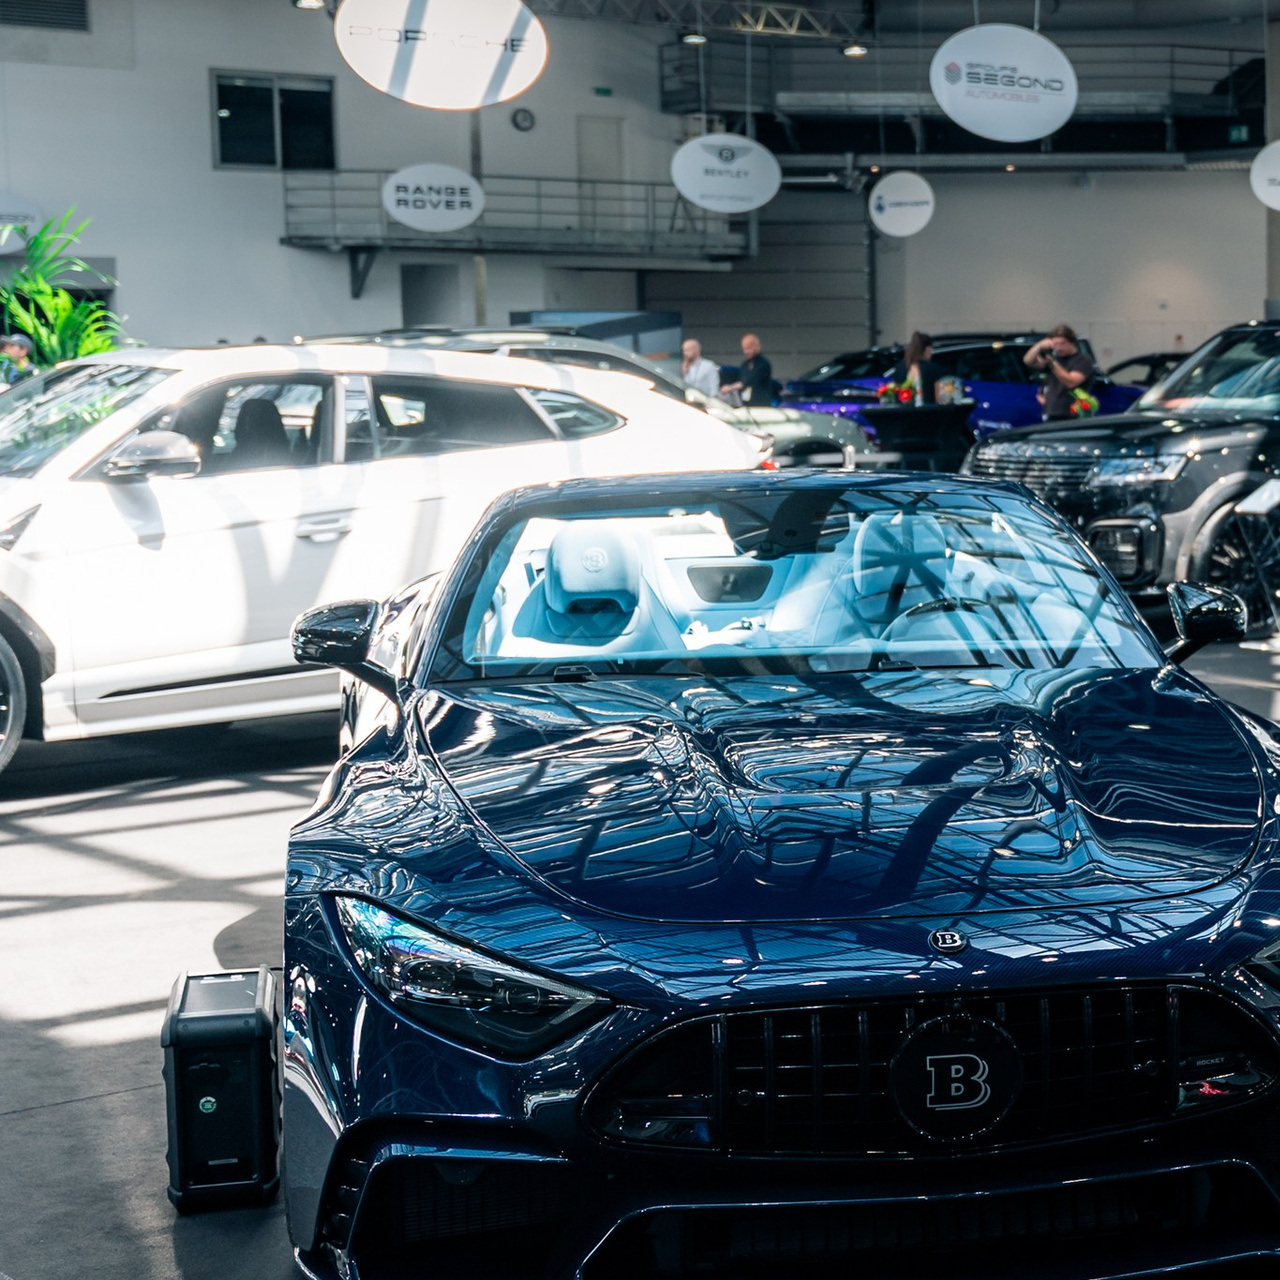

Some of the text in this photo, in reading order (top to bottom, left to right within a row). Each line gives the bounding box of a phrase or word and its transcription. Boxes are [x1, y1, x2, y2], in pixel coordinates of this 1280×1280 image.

[349, 25, 530, 53] PORCHE
[965, 71, 1064, 92] SEGOND
[703, 167, 750, 179] BENTLEY
[395, 185, 471, 197] RANGE
[395, 198, 473, 210] ROVER
[936, 932, 962, 947] B
[1196, 1056, 1225, 1067] ROCKET
[926, 1053, 991, 1111] B
